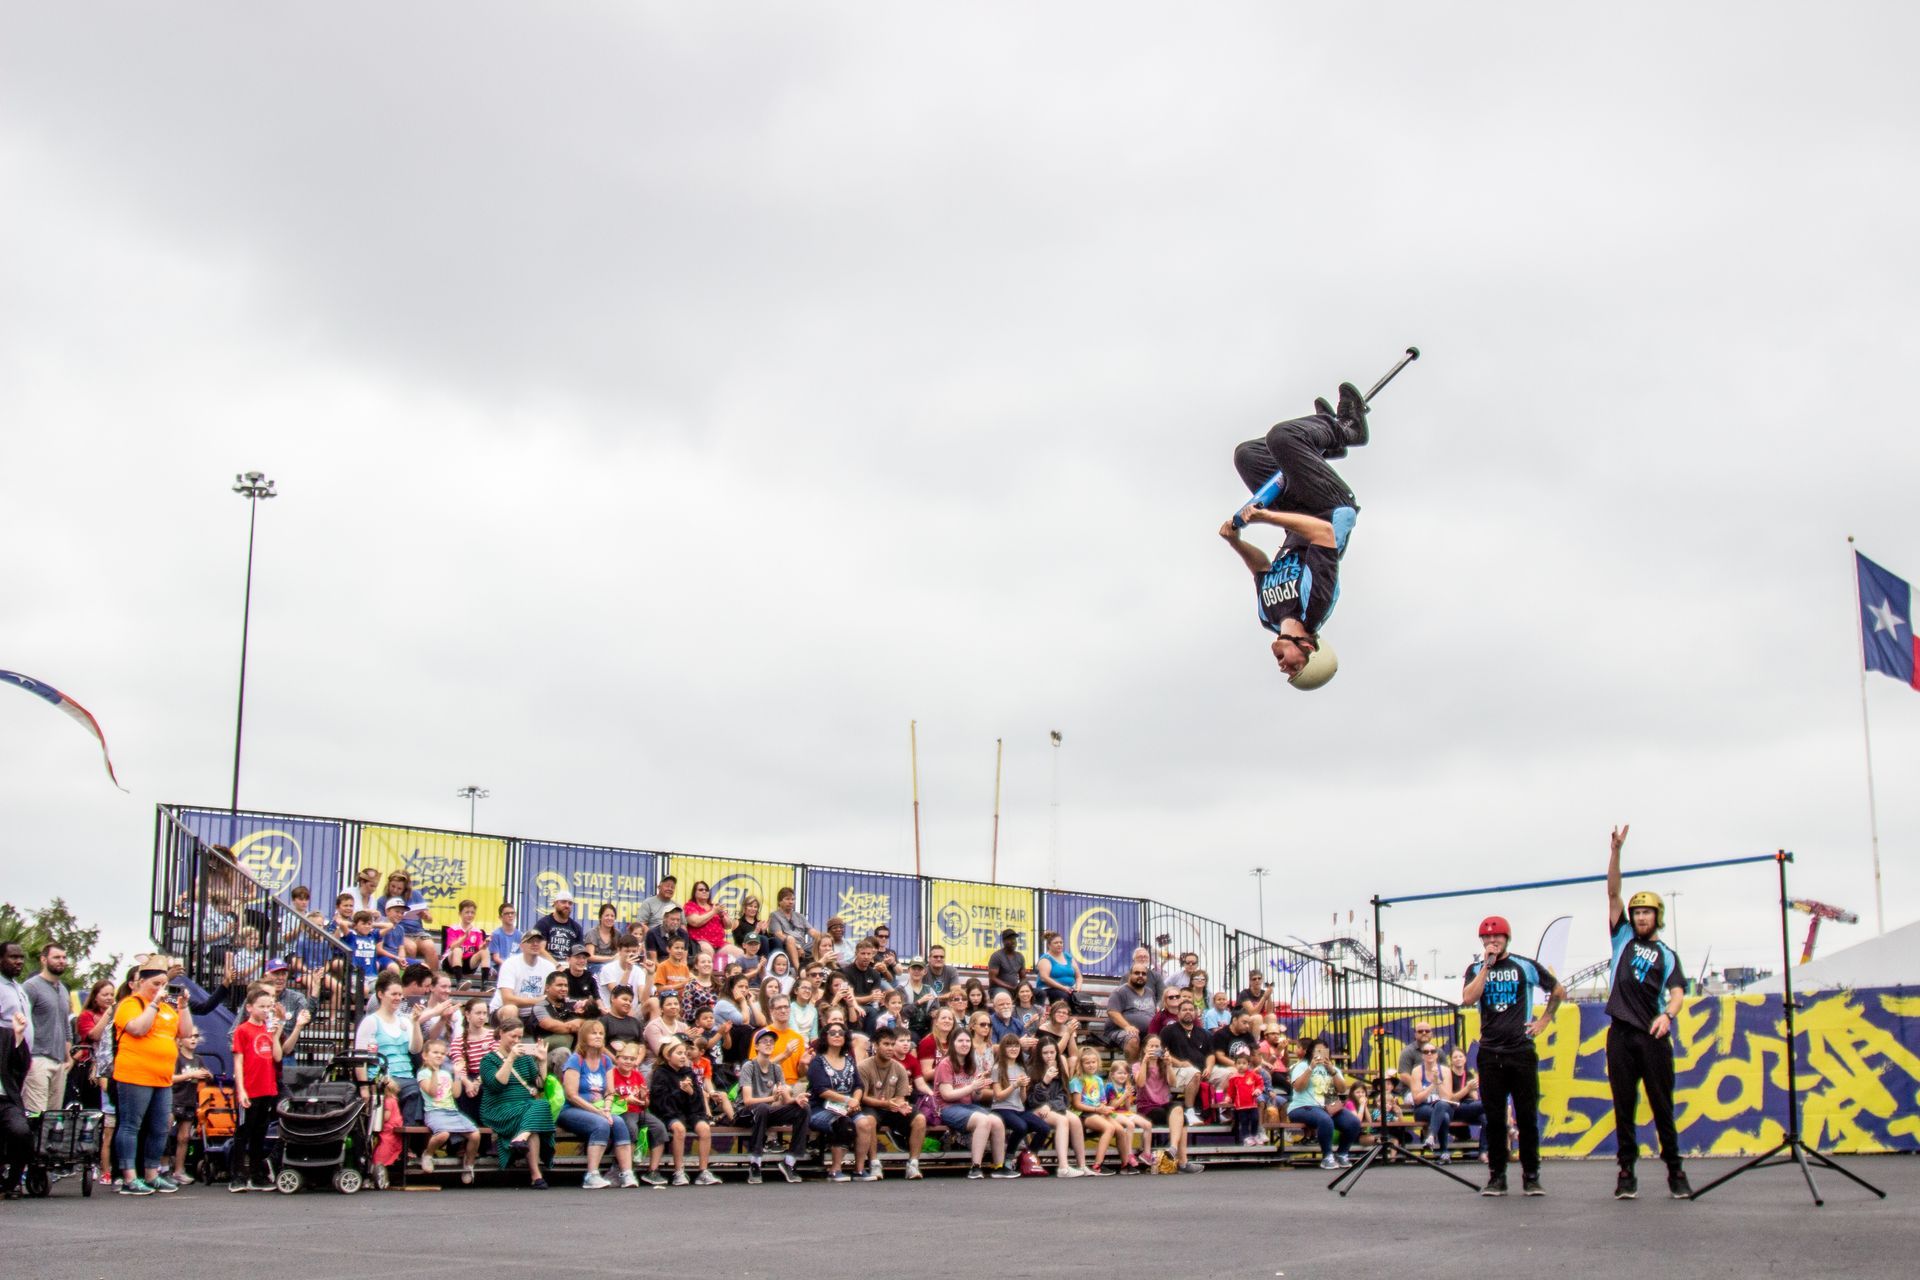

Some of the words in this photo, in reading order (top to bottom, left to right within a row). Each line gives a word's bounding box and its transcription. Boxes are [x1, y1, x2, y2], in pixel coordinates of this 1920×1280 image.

[1262, 567, 1302, 590] STUNT
[1262, 579, 1299, 608] XPOGO
[241, 844, 297, 882] 24
[573, 871, 614, 890] STATE
[617, 875, 646, 893] FAIR
[602, 889, 617, 899] OF
[572, 897, 642, 924] TEAS
[971, 905, 1002, 921] STATE
[1005, 908, 1027, 923] FAIR
[994, 921, 1004, 929] OF
[1082, 918, 1116, 946] 24
[972, 927, 1027, 951] TEXS
[1484, 980, 1520, 993] STUNT
[1485, 992, 1518, 1005] TEAM
